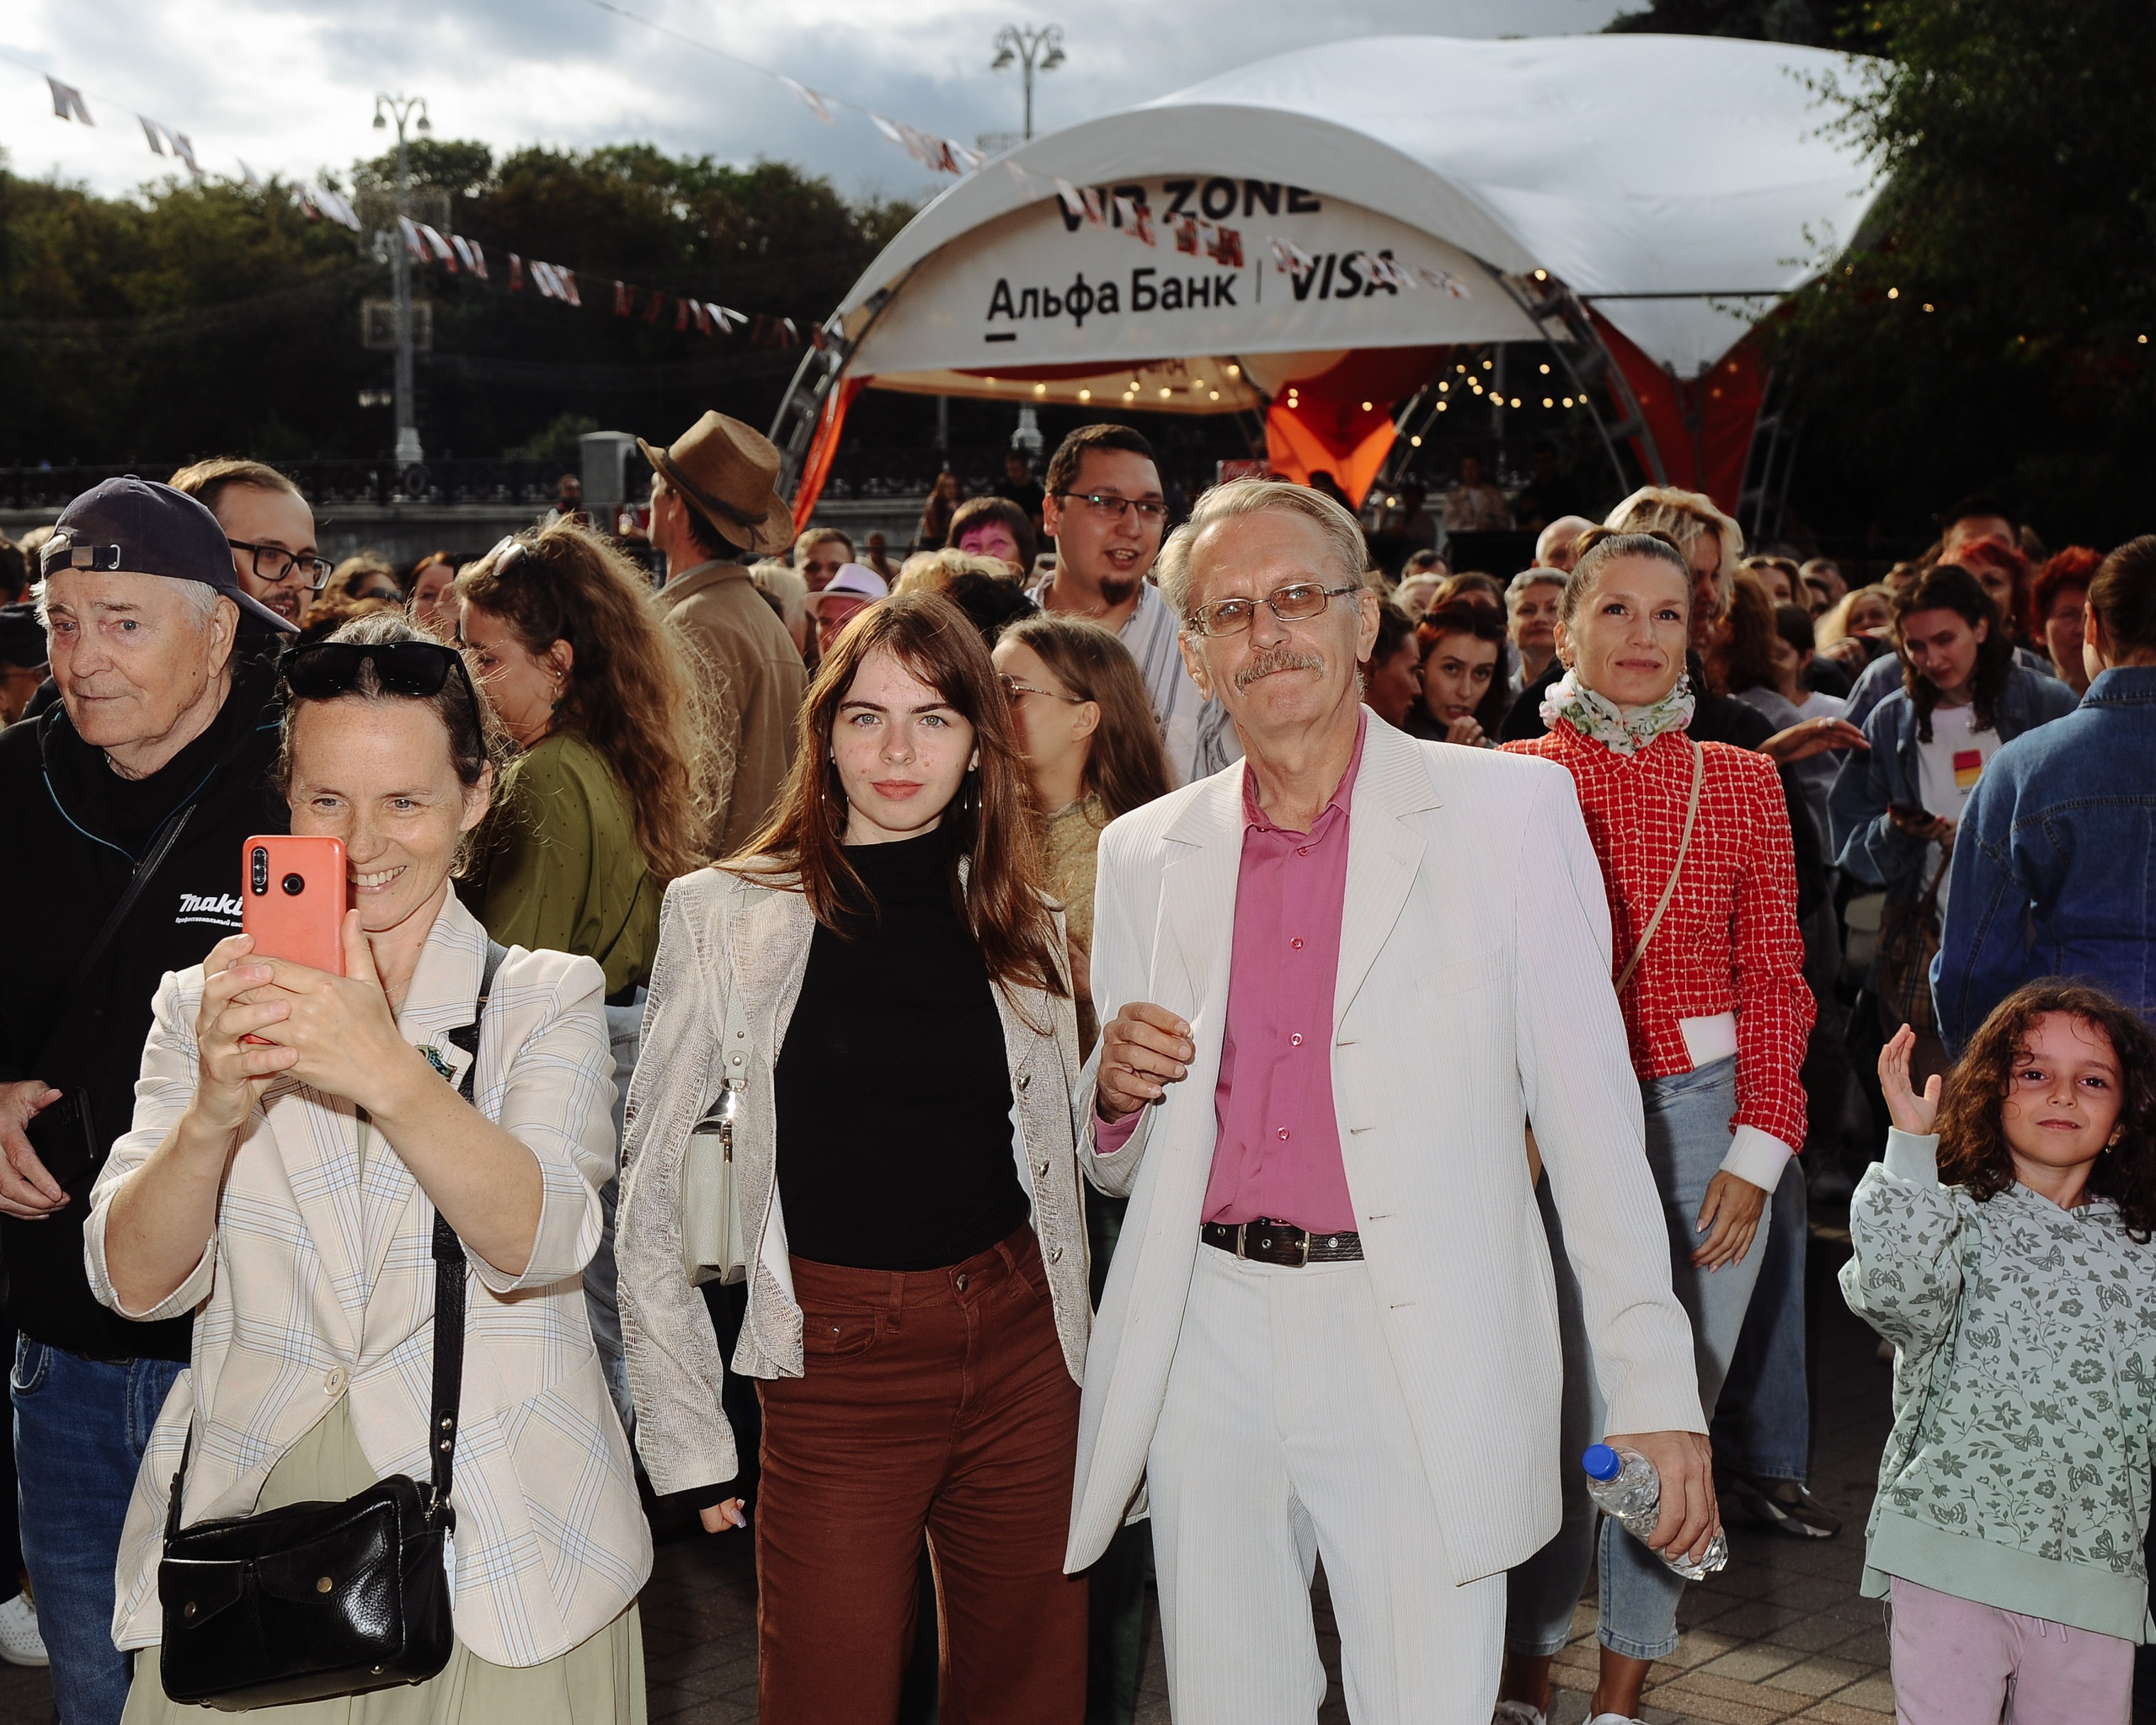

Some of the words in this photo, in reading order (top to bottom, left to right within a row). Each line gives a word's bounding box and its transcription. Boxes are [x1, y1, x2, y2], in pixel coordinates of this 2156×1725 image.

[1162, 177, 1321, 225] ZONE
[987, 273, 1120, 327] Альфа
[1131, 268, 1238, 312] Банк
[1287, 249, 1398, 301] VISA
